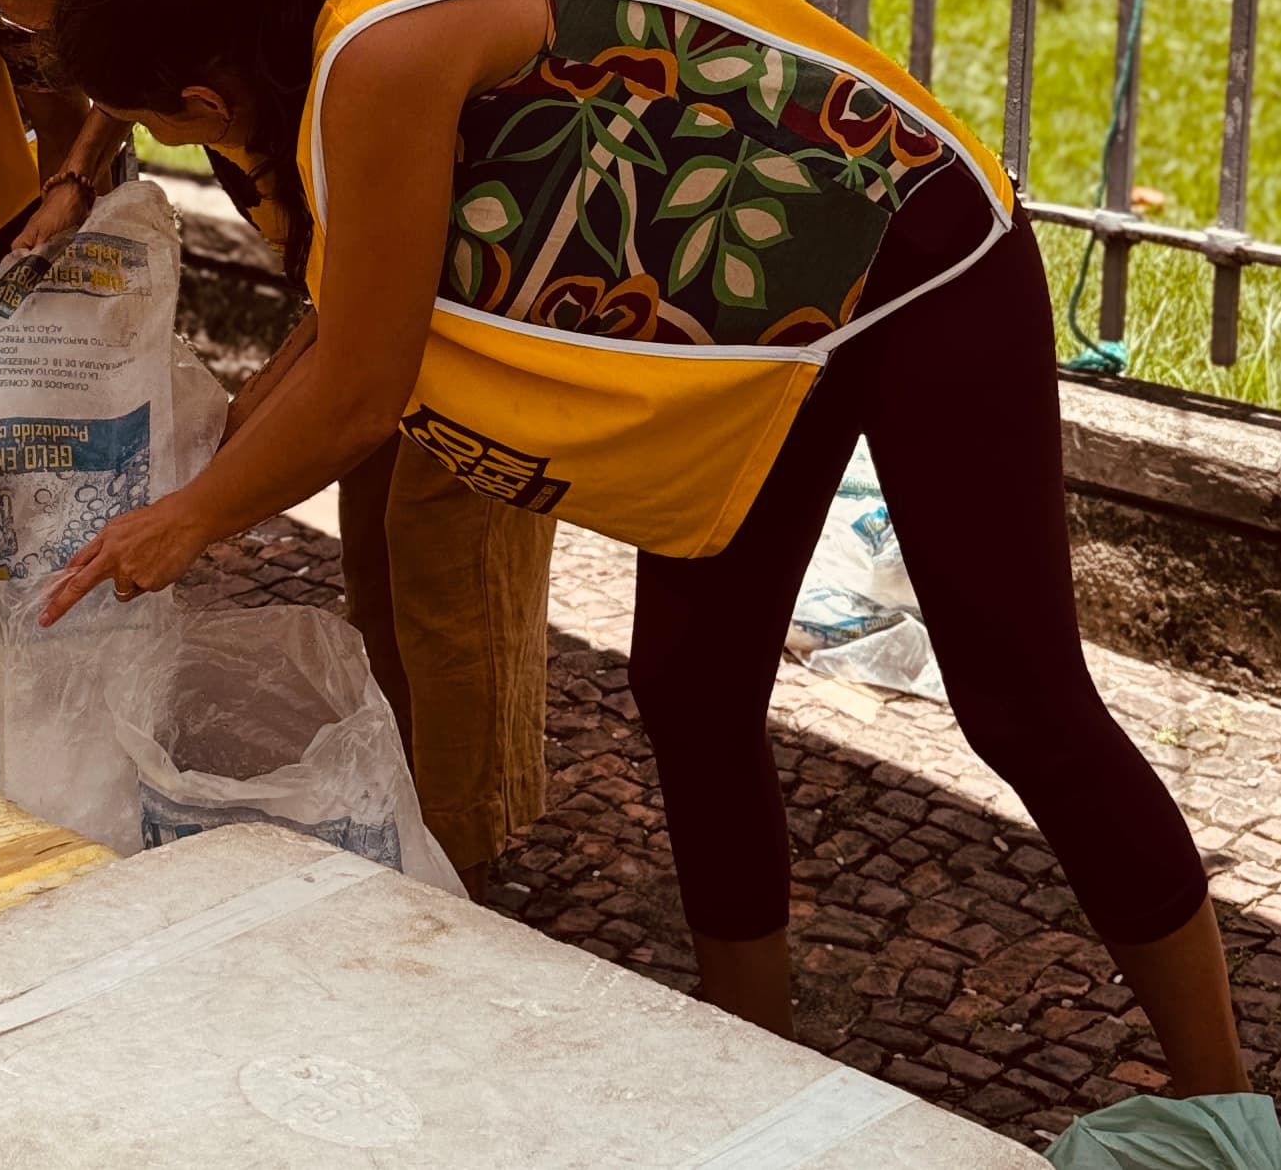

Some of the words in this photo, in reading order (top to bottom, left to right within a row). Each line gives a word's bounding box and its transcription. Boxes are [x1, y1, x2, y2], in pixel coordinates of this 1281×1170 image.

[30, 379, 42, 389] DE
[43, 380, 89, 392] CUIDADOS
[12, 423, 89, 443] Produzido
[24, 445, 73, 470] GELO
